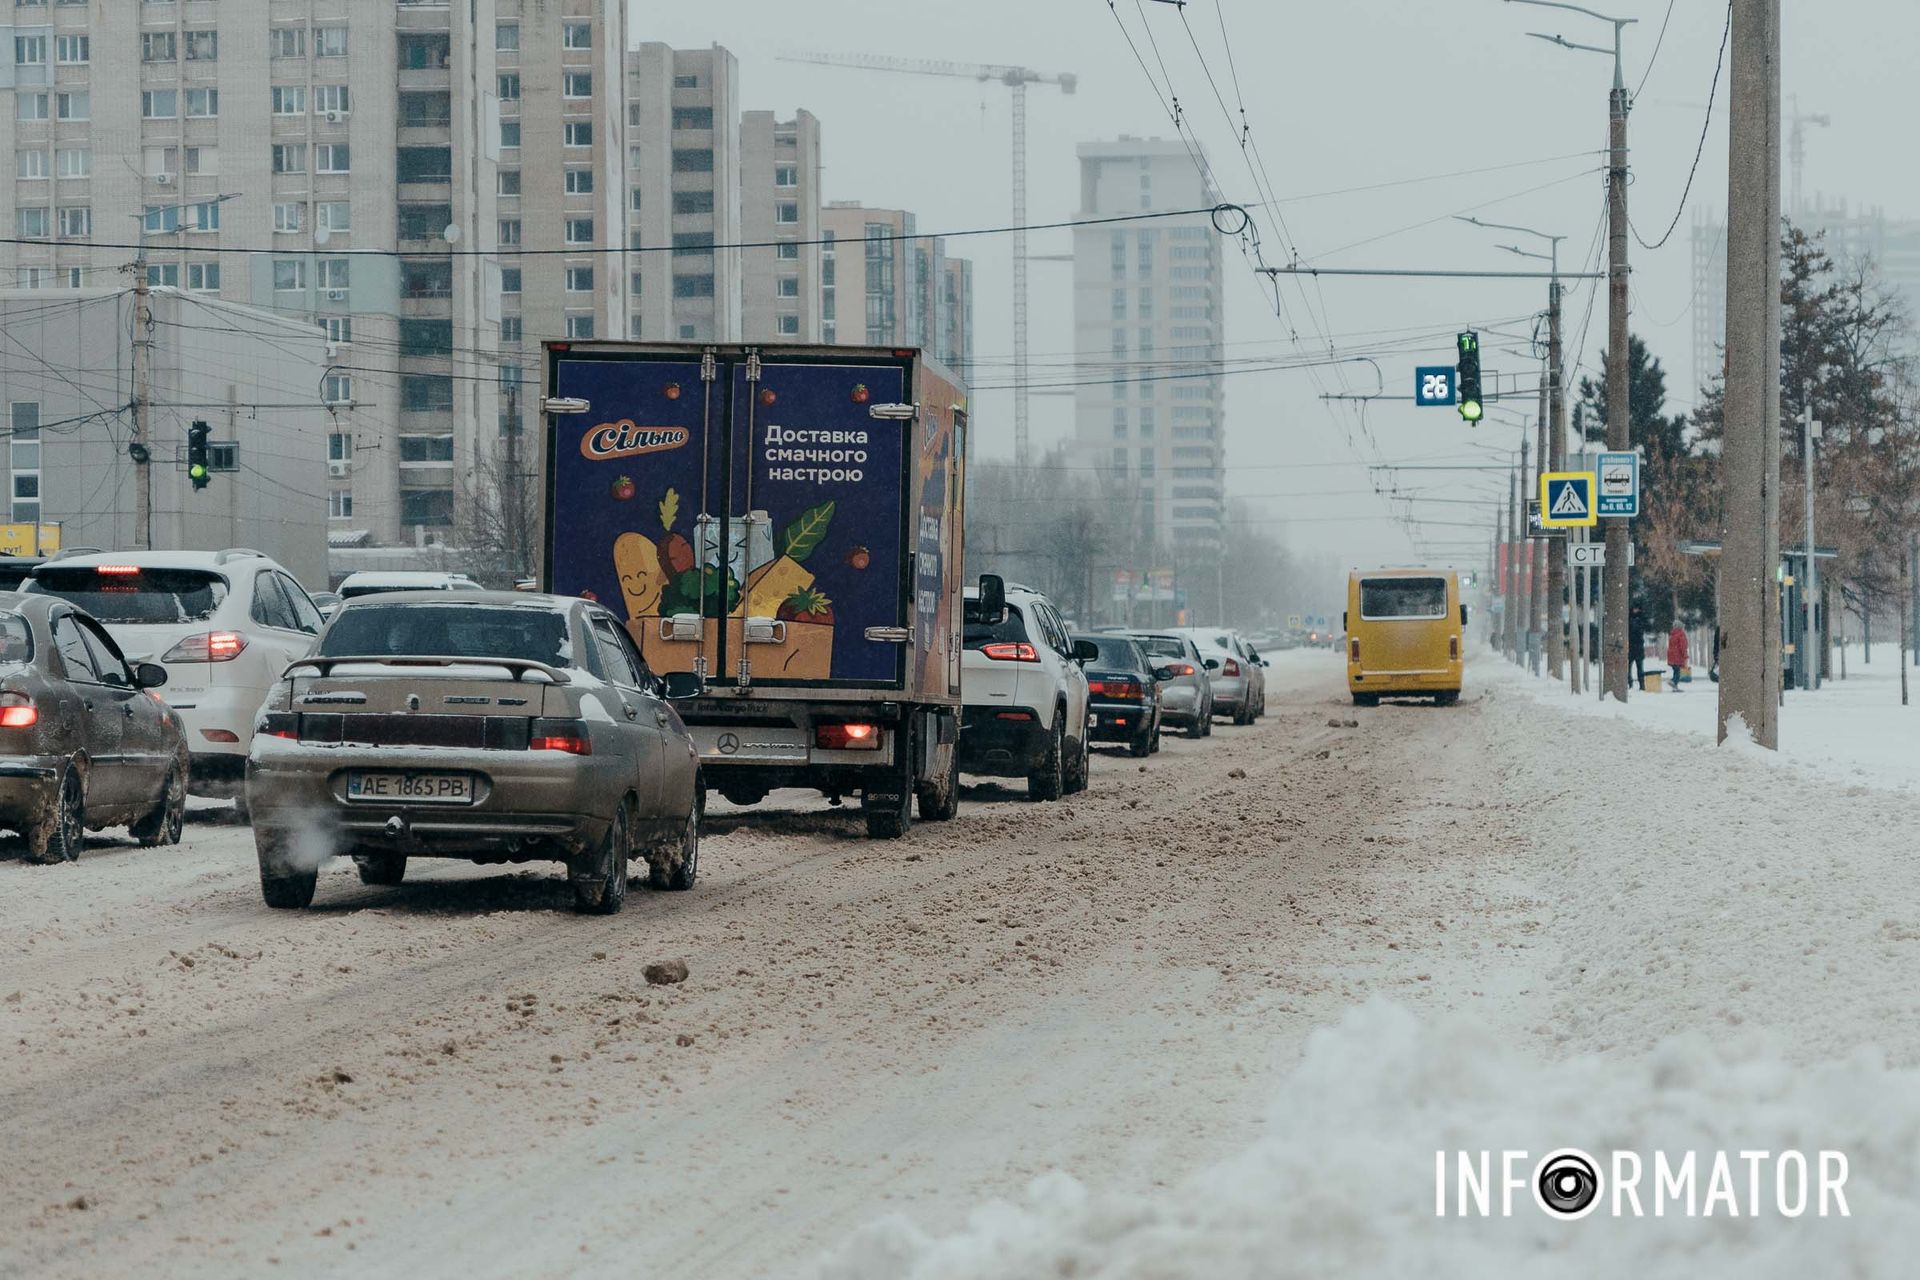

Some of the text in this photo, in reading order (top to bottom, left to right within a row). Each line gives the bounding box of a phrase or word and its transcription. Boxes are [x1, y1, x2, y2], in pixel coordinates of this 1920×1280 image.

[1422, 374, 1448, 400] 26
[590, 423, 685, 454] Сільпо
[764, 425, 868, 445] Доставка
[765, 449, 868, 463] смачного
[768, 468, 864, 485] настрою
[1575, 547, 1607, 562] СТ
[362, 777, 464, 797] AE 1865 PB
